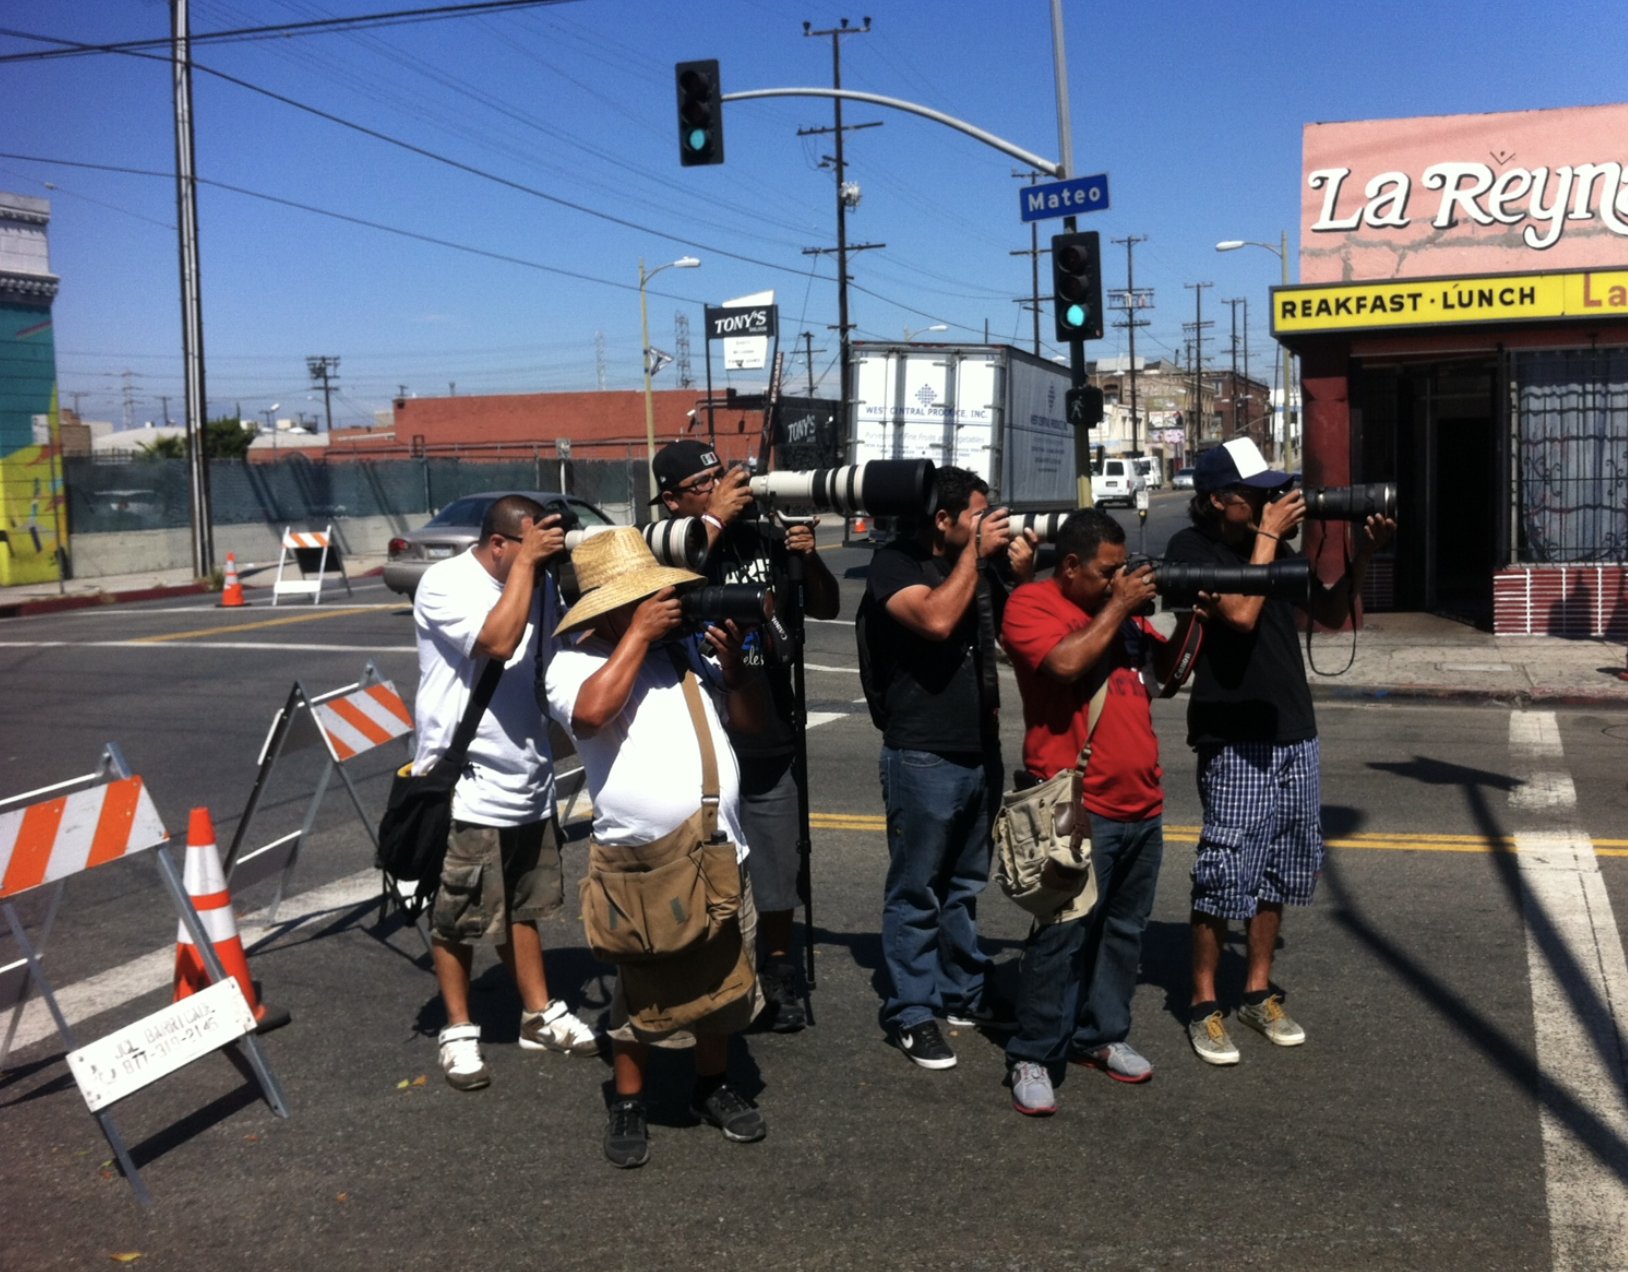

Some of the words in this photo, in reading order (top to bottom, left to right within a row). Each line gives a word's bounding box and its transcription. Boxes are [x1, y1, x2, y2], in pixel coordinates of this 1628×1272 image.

[1027, 186, 1101, 212] Mateo
[1308, 167, 1412, 233] La
[1281, 293, 1423, 320] REAKFAST
[1442, 286, 1536, 310] LUNCH
[715, 310, 766, 333] TONY'S
[890, 407, 926, 417] CENTRAL
[1174, 652, 1191, 680] Canon
